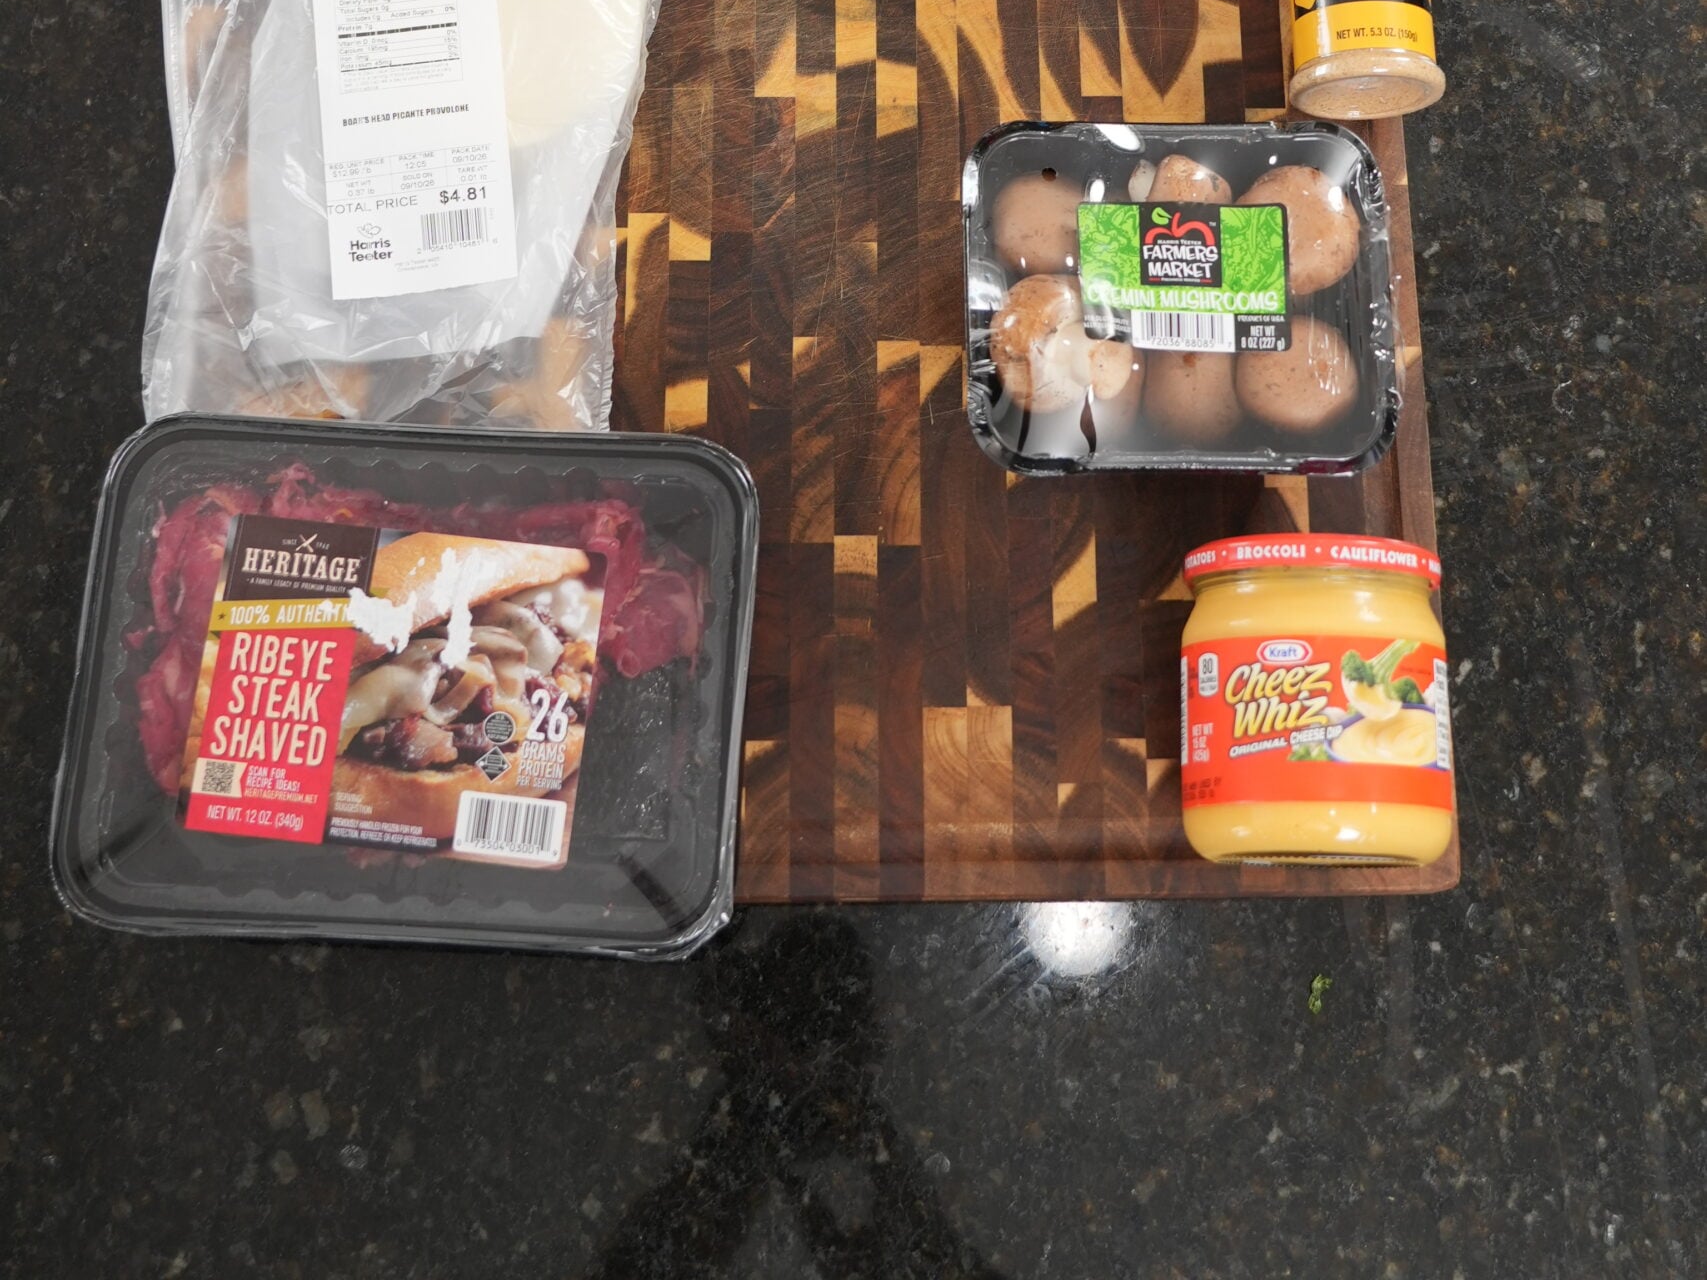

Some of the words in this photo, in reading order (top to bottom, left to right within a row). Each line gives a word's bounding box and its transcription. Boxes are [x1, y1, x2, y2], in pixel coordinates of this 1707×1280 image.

[1336, 29, 1351, 40] NET
[1354, 28, 1368, 38] WT.
[1370, 27, 1383, 37] 5.3
[1384, 27, 1397, 37] OZ.
[1398, 29, 1418, 43] (150g)
[371, 113, 391, 123] HEAD
[392, 108, 424, 121] PICANTE
[426, 104, 470, 116] PROVOLONE
[327, 202, 371, 216] TOTAL
[376, 195, 419, 211] PRICE
[440, 185, 486, 205] $4.81
[350, 237, 391, 251] Harris
[1143, 244, 1219, 262] FARMERS
[349, 250, 393, 262] Teeter
[1148, 261, 1213, 279] MARKET
[1159, 289, 1279, 312] MUSHROOMS
[1250, 325, 1264, 337] NET
[1264, 325, 1276, 337] WT
[1151, 337, 1180, 347] 72036
[1185, 337, 1215, 348] 88085
[1241, 336, 1247, 349] 8
[1247, 336, 1258, 349] OZ
[1258, 336, 1276, 350] (227
[242, 547, 361, 584] HERITAGE
[1236, 544, 1306, 560] BROCCOLI
[1330, 545, 1419, 568] CAULIFLOWER
[255, 578, 273, 586] FAMILY
[274, 580, 292, 588] LEGACY
[301, 582, 325, 592] PREMIUM
[325, 584, 346, 593] QUALITY
[230, 604, 271, 625] 100%
[276, 603, 351, 624] AUTHENTI
[230, 631, 338, 681] RIBEYE
[1269, 647, 1297, 658] Kraft
[1202, 658, 1214, 675] 80
[1225, 662, 1333, 705] Cheez
[228, 674, 324, 723] STEAK
[526, 687, 569, 743] 26
[1233, 690, 1329, 739] Whiz
[210, 715, 328, 767] SHAVED
[1229, 737, 1289, 758] ORIGINAL
[1289, 727, 1326, 745] CHEESE
[1325, 724, 1344, 740] DIP
[522, 741, 567, 764] GRAMS
[249, 765, 269, 778] SCAN
[270, 767, 287, 780] FOR
[519, 761, 565, 780] PROTEIN
[247, 776, 273, 789] RECIPE
[275, 779, 301, 793] IDEAS!
[516, 775, 531, 786] PER
[533, 778, 563, 790] SERVING
[244, 788, 319, 805] HERITAGEPREMIUM.NET
[207, 804, 225, 820] NET
[227, 806, 243, 822] WT.
[245, 809, 257, 823] 12
[258, 810, 273, 826] OZ.
[275, 812, 304, 832] (340g)
